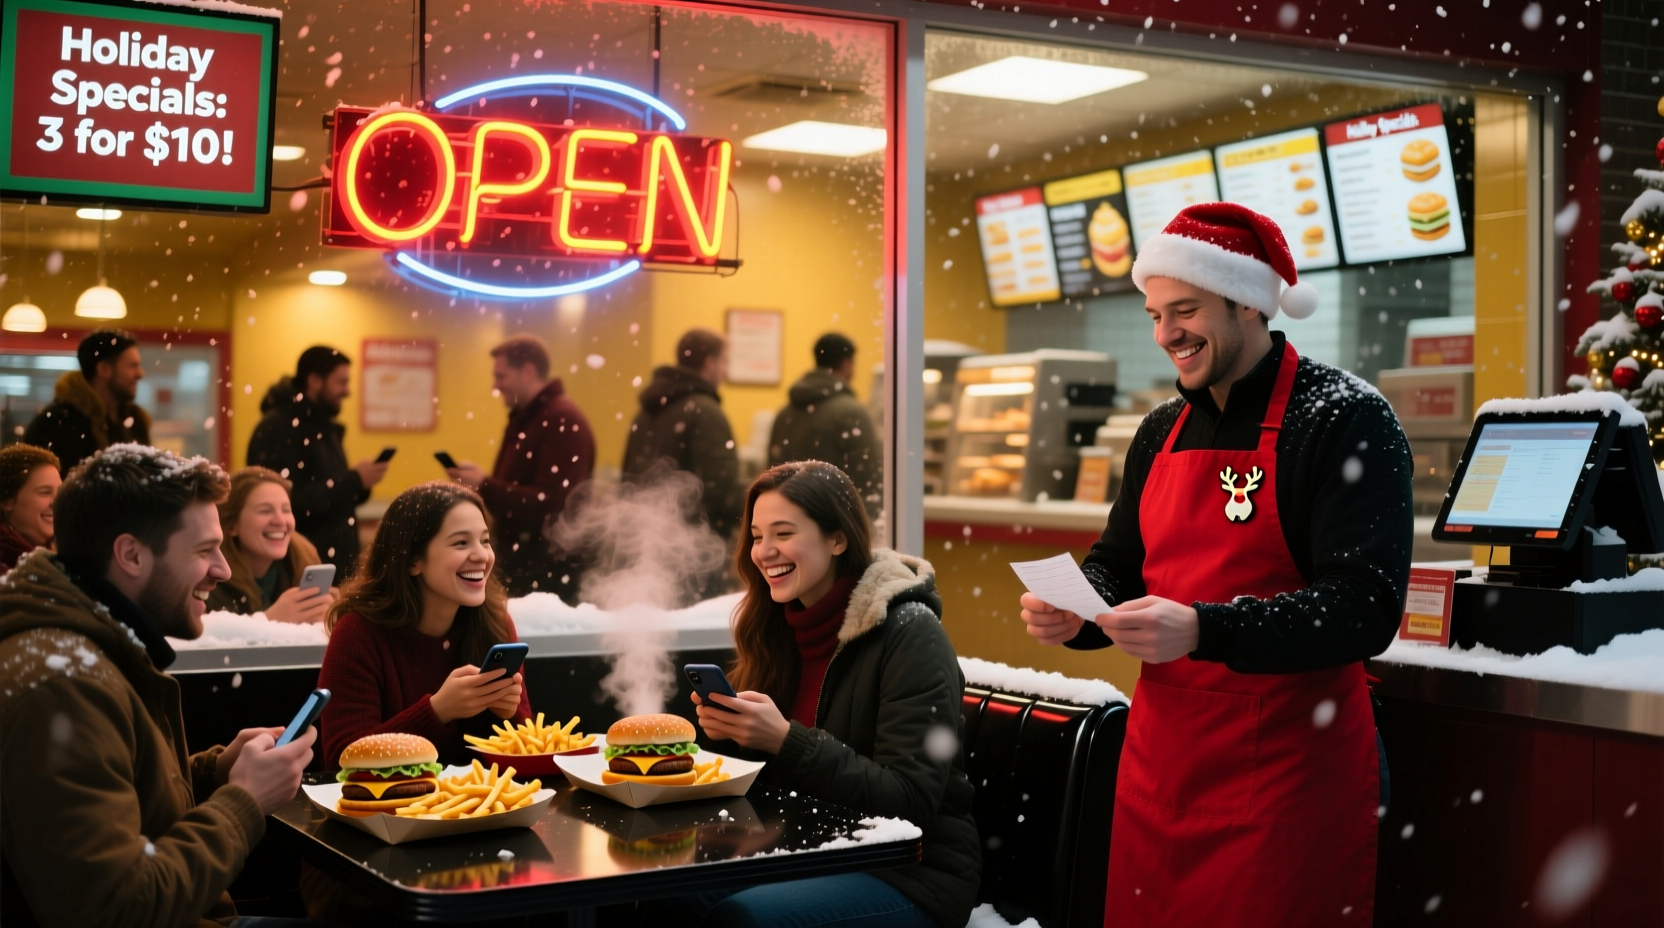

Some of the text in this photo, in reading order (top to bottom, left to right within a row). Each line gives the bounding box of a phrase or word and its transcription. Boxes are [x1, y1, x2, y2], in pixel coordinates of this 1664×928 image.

[61, 25, 215, 82] Holiday
[50, 69, 227, 119] Specials:
[36, 115, 234, 167] 3 for $10!
[345, 111, 732, 257] OPEN
